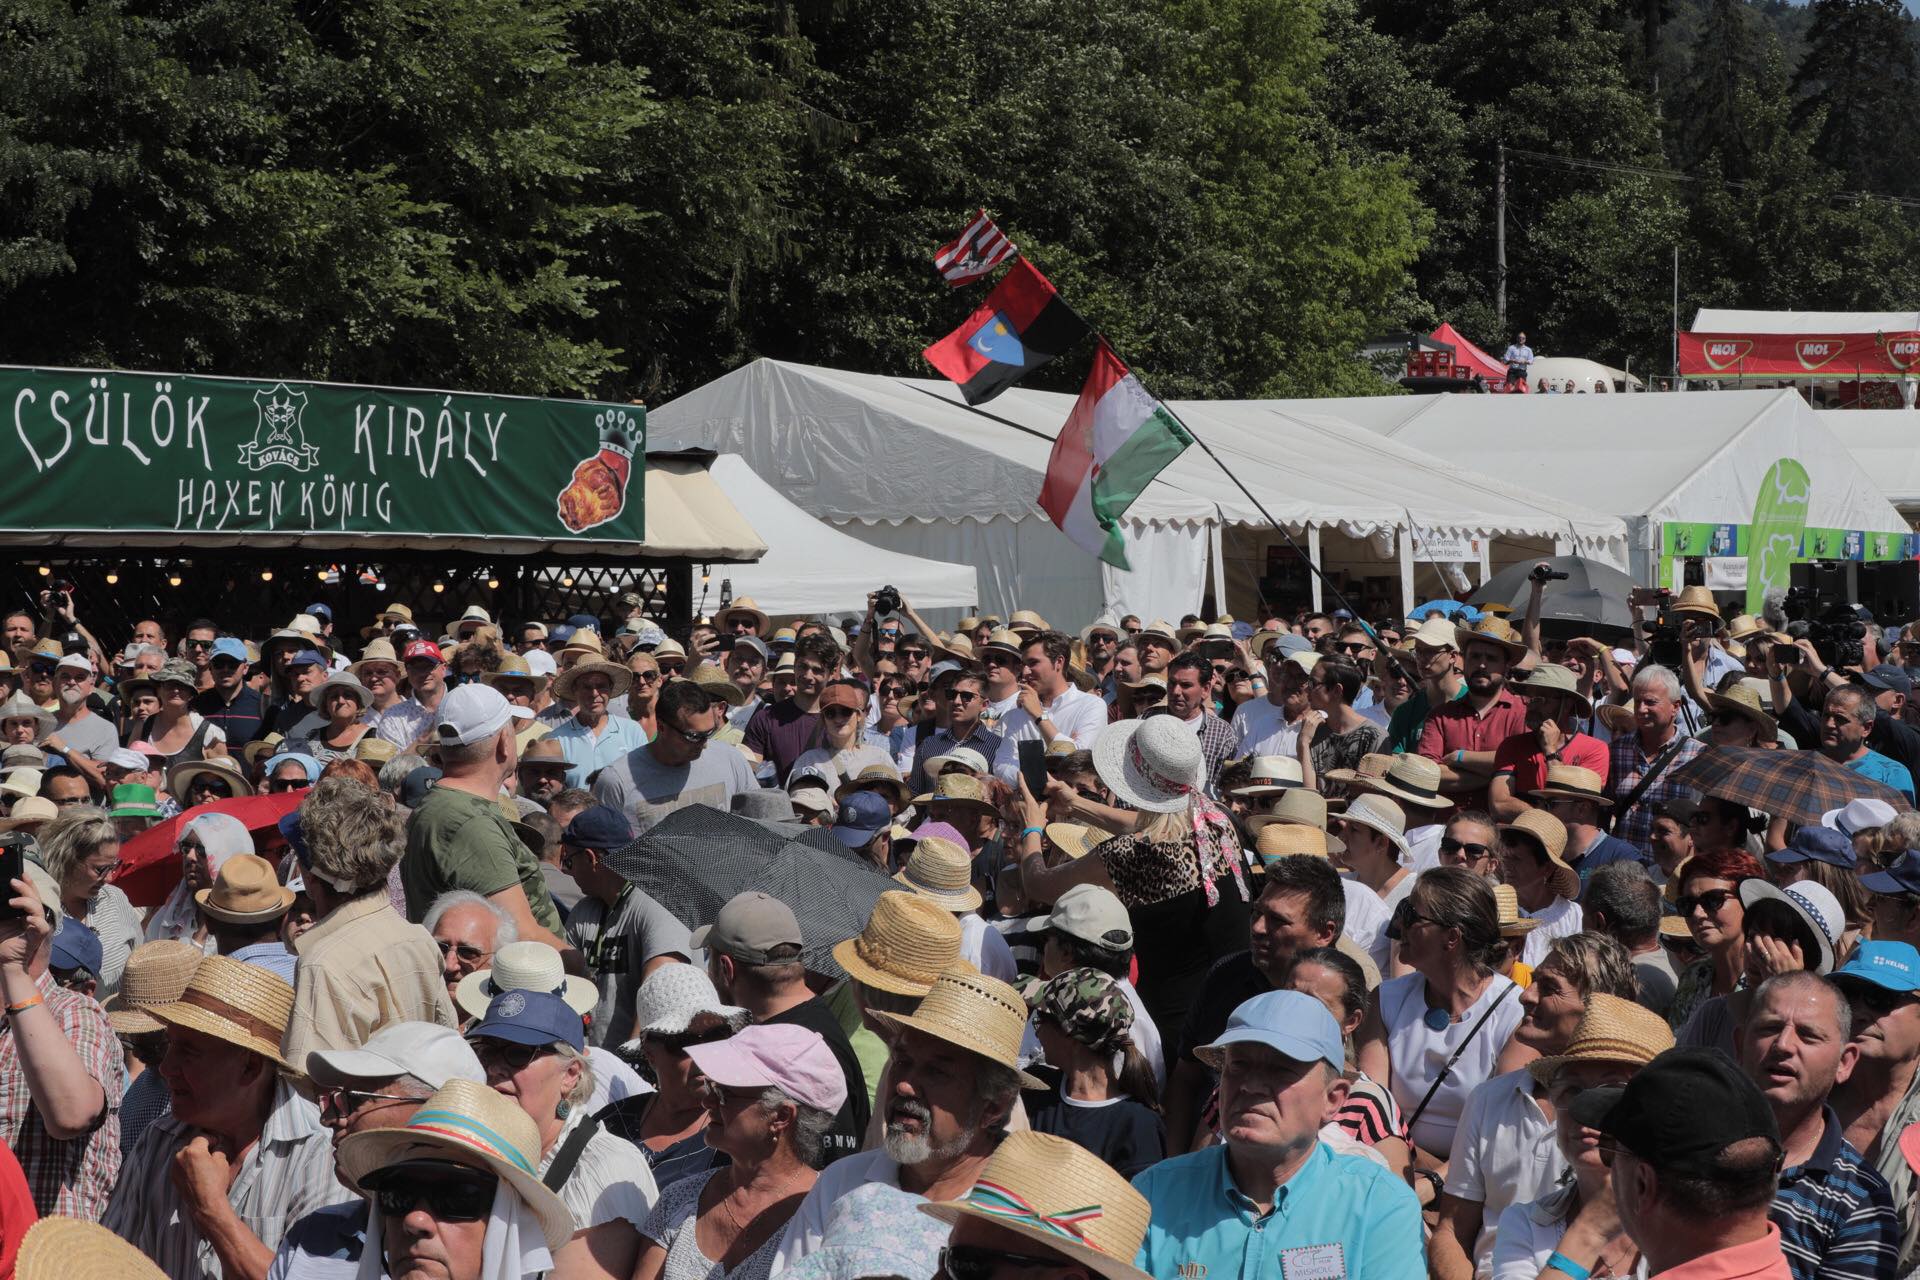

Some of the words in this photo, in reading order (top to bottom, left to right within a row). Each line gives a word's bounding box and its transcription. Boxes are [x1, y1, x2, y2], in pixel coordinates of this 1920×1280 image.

[1710, 343, 1737, 356] MOL
[1802, 343, 1829, 356] MOL
[1893, 342, 1920, 355] MOL
[14, 376, 213, 473] CSÜLÖK
[354, 394, 508, 479] KIRÁLY
[258, 447, 300, 467] KOVÁCS
[174, 478, 285, 531] HAXEN
[300, 473, 392, 531] KÖNIG
[408, 642, 435, 656] USA
[822, 1134, 856, 1149] BMW
